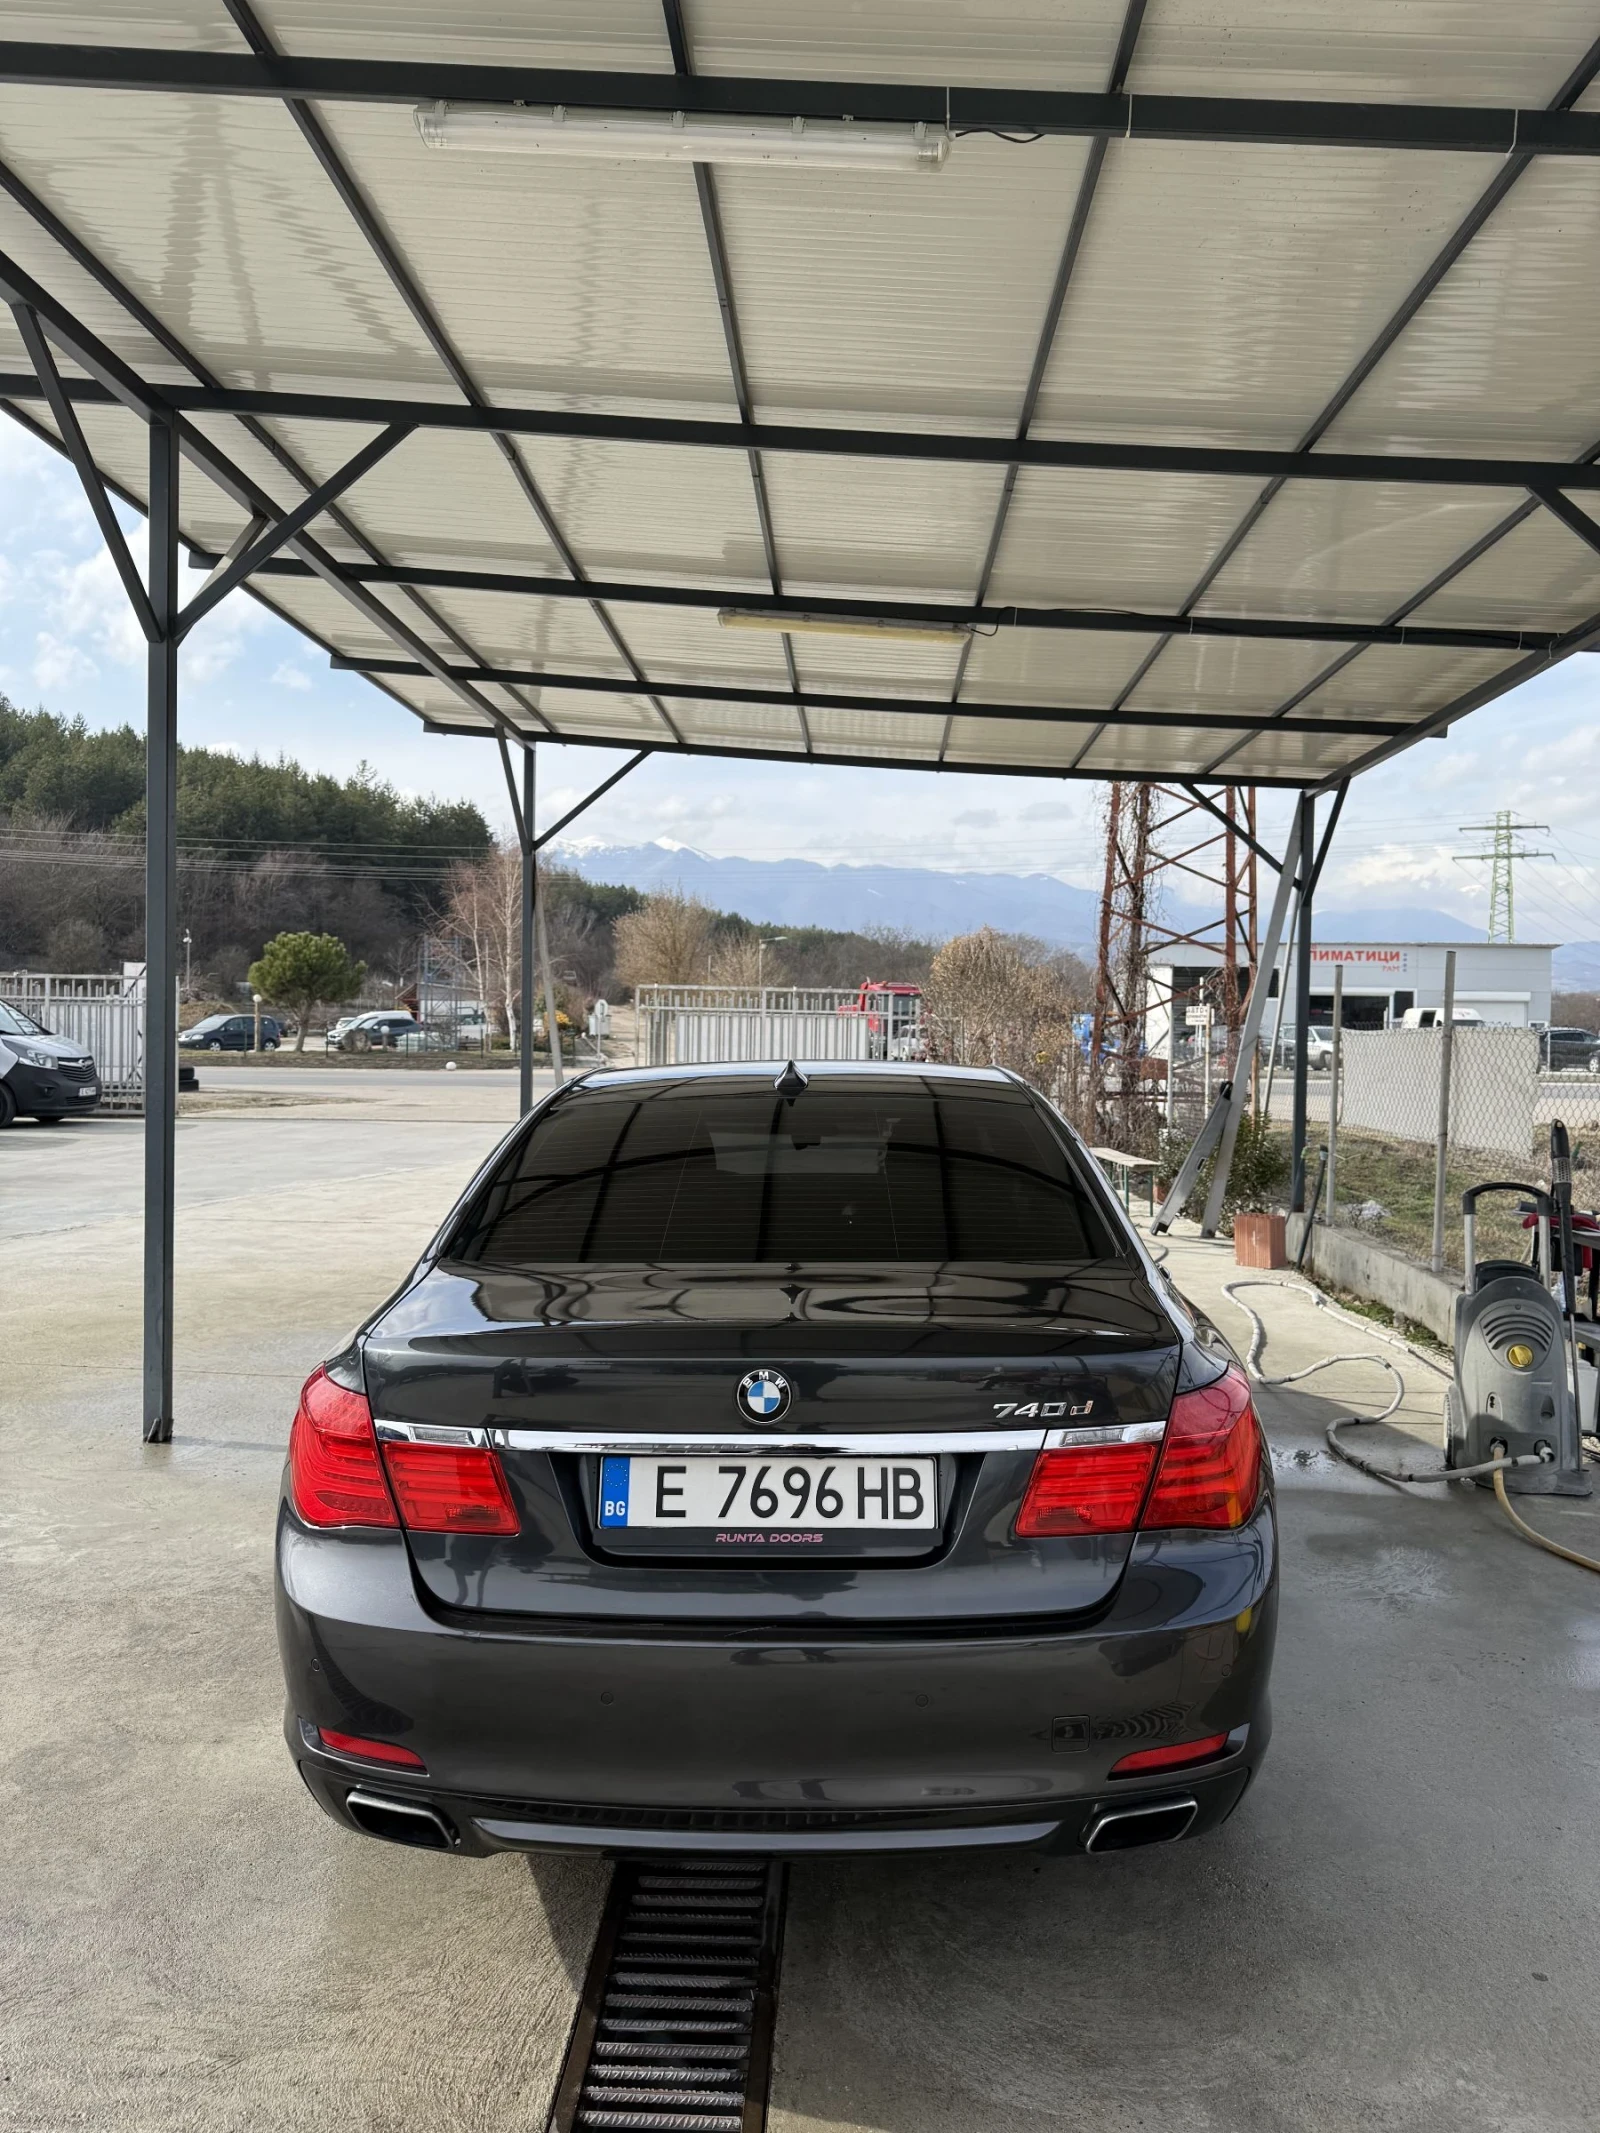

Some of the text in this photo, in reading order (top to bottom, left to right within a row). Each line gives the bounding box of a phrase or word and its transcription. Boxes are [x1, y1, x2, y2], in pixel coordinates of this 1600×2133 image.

[742, 1371, 788, 1389] BMW
[993, 1400, 1094, 1418] 740d
[656, 1466, 924, 1520] E 7696 HB
[604, 1501, 626, 1516] BG
[715, 1533, 824, 1543] RUNTA DOORS
